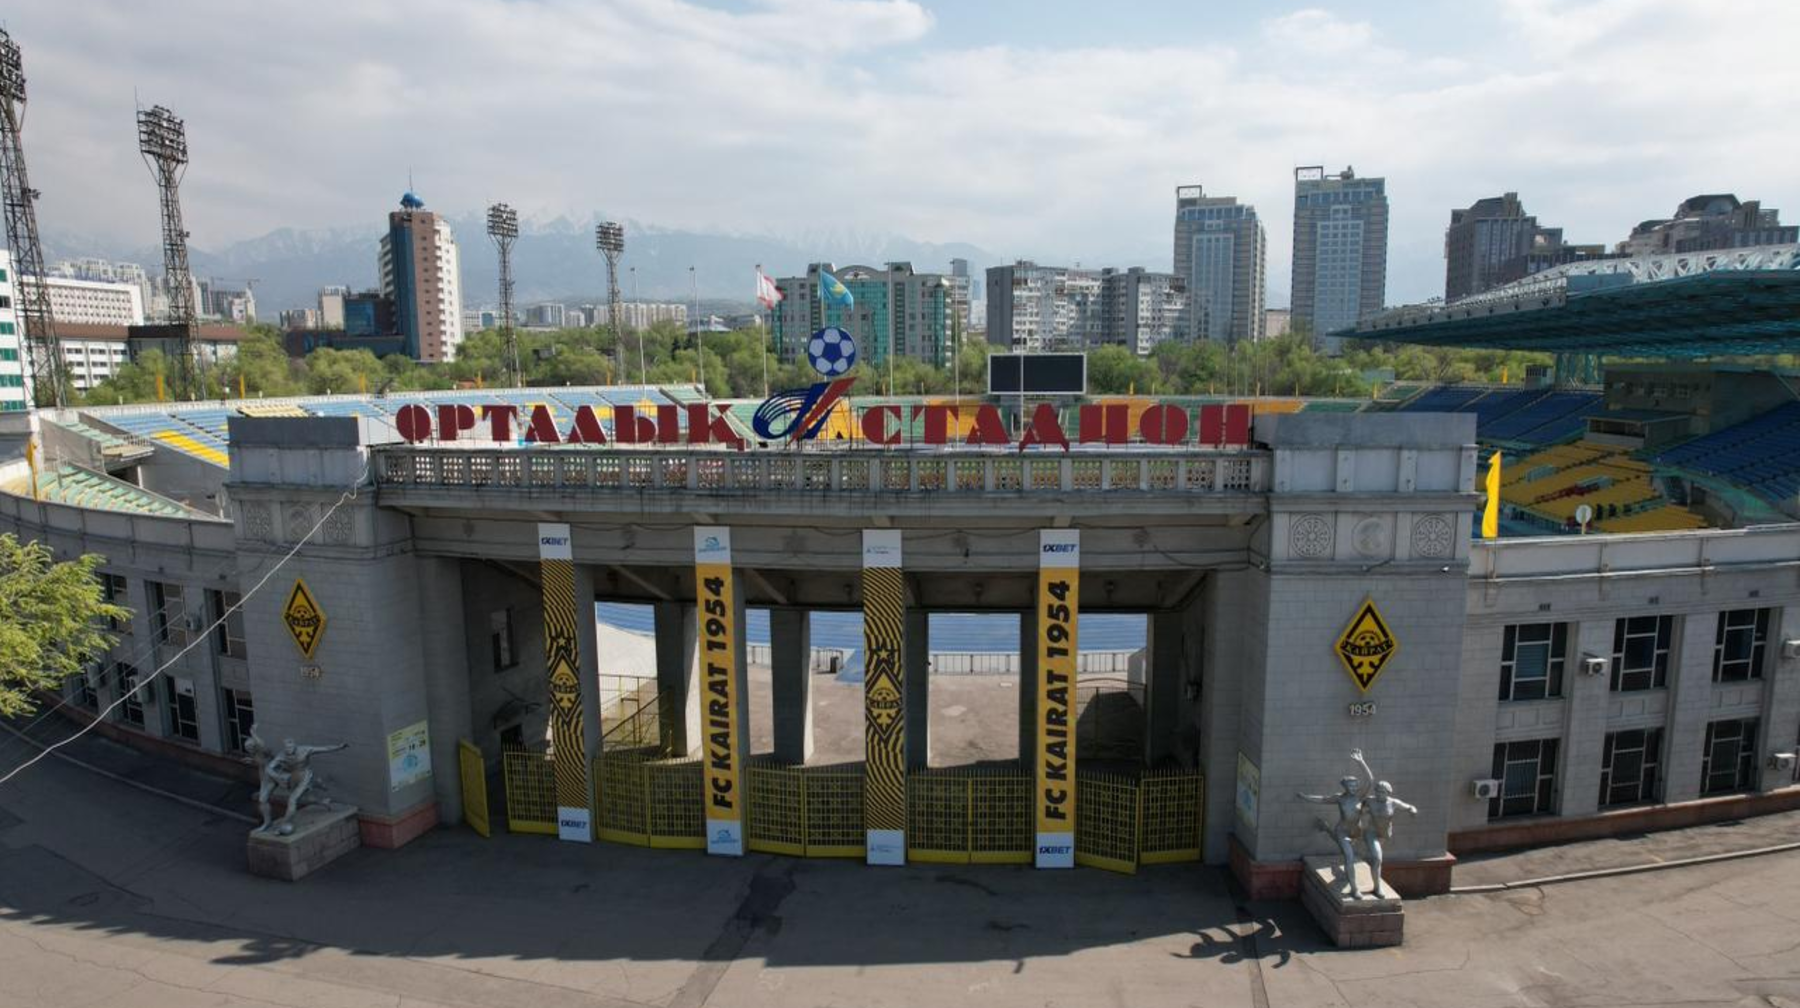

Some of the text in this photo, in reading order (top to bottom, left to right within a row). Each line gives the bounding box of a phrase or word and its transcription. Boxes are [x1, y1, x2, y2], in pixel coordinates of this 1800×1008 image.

[395, 403, 1250, 452] ОРТАЛЫҚ СТАДИОН
[1043, 543, 1077, 553] 1XBET
[703, 576, 727, 652] 1954
[707, 662, 733, 772] KAIRAT
[1044, 579, 1071, 821] FC KAIRAT 1954
[1349, 704, 1377, 716] 1954
[711, 777, 734, 810] FC
[1039, 845, 1072, 854] 1XBET
